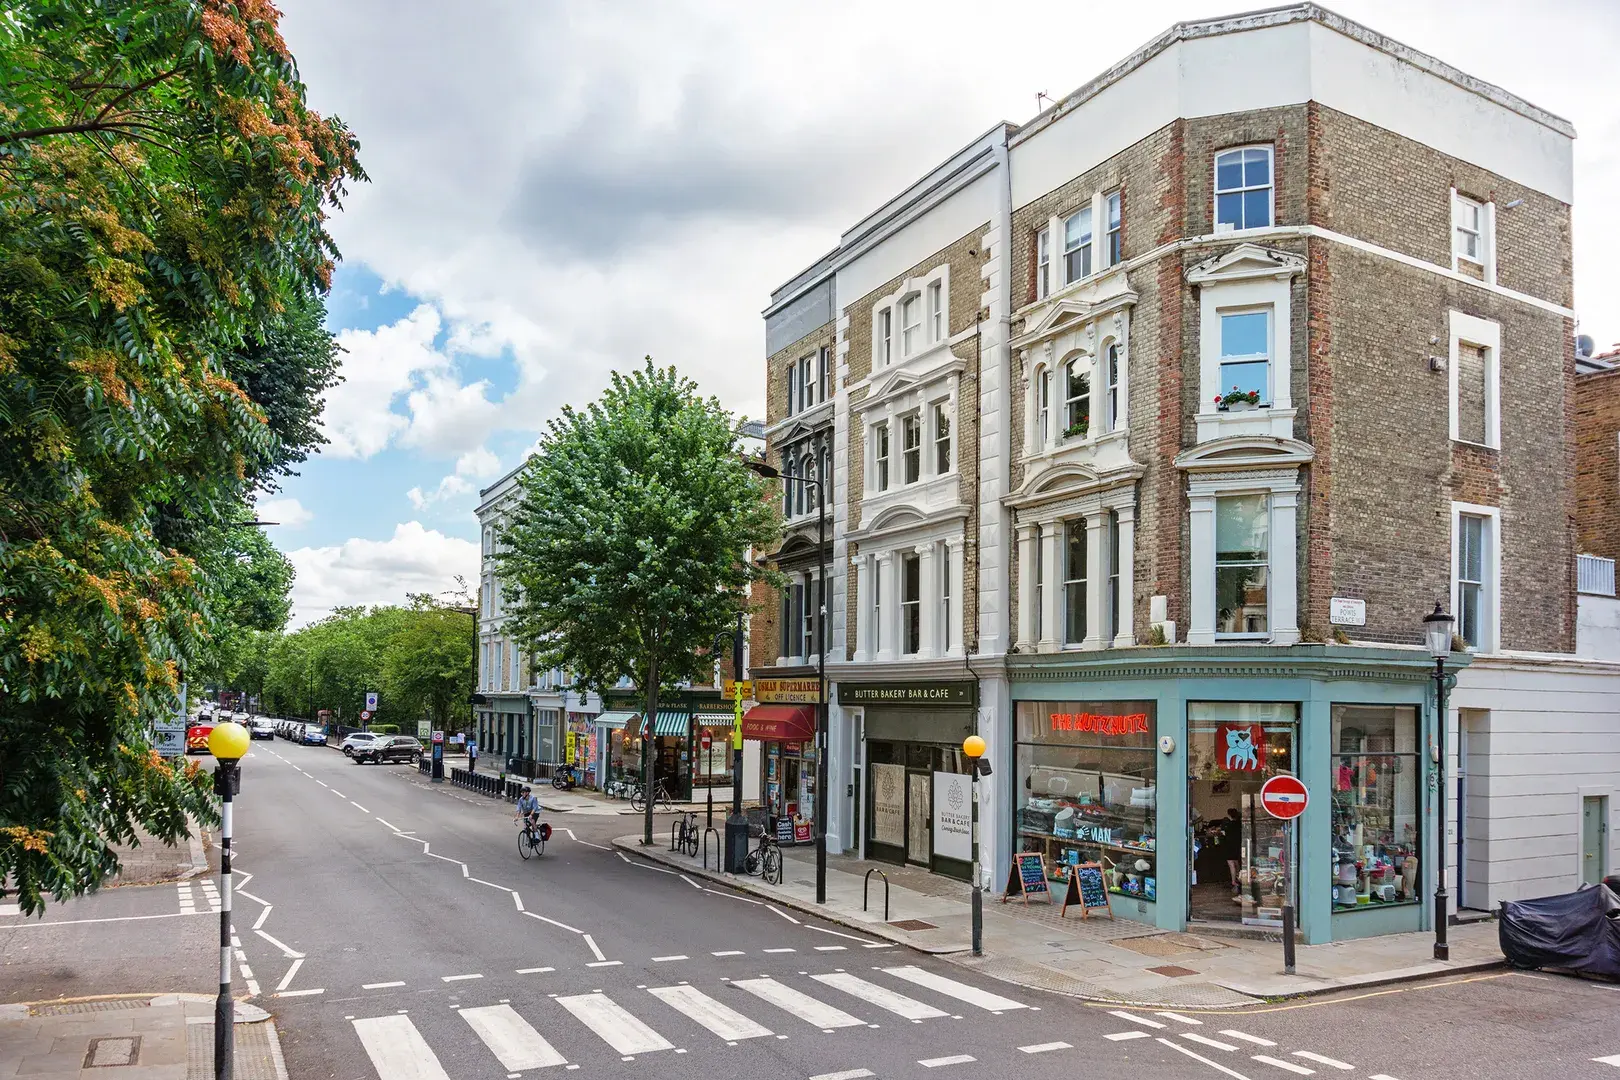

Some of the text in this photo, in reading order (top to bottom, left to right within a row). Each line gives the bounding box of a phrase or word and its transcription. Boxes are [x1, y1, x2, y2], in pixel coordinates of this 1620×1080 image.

[779, 681, 820, 692] SUPERMARKE
[785, 693, 806, 701] LICENCE
[854, 688, 949, 699] BUTTER BAKERY BAR & CAFE
[1051, 713, 1071, 731] THE
[941, 816, 952, 824] BAR
[956, 819, 970, 827] CAFE
